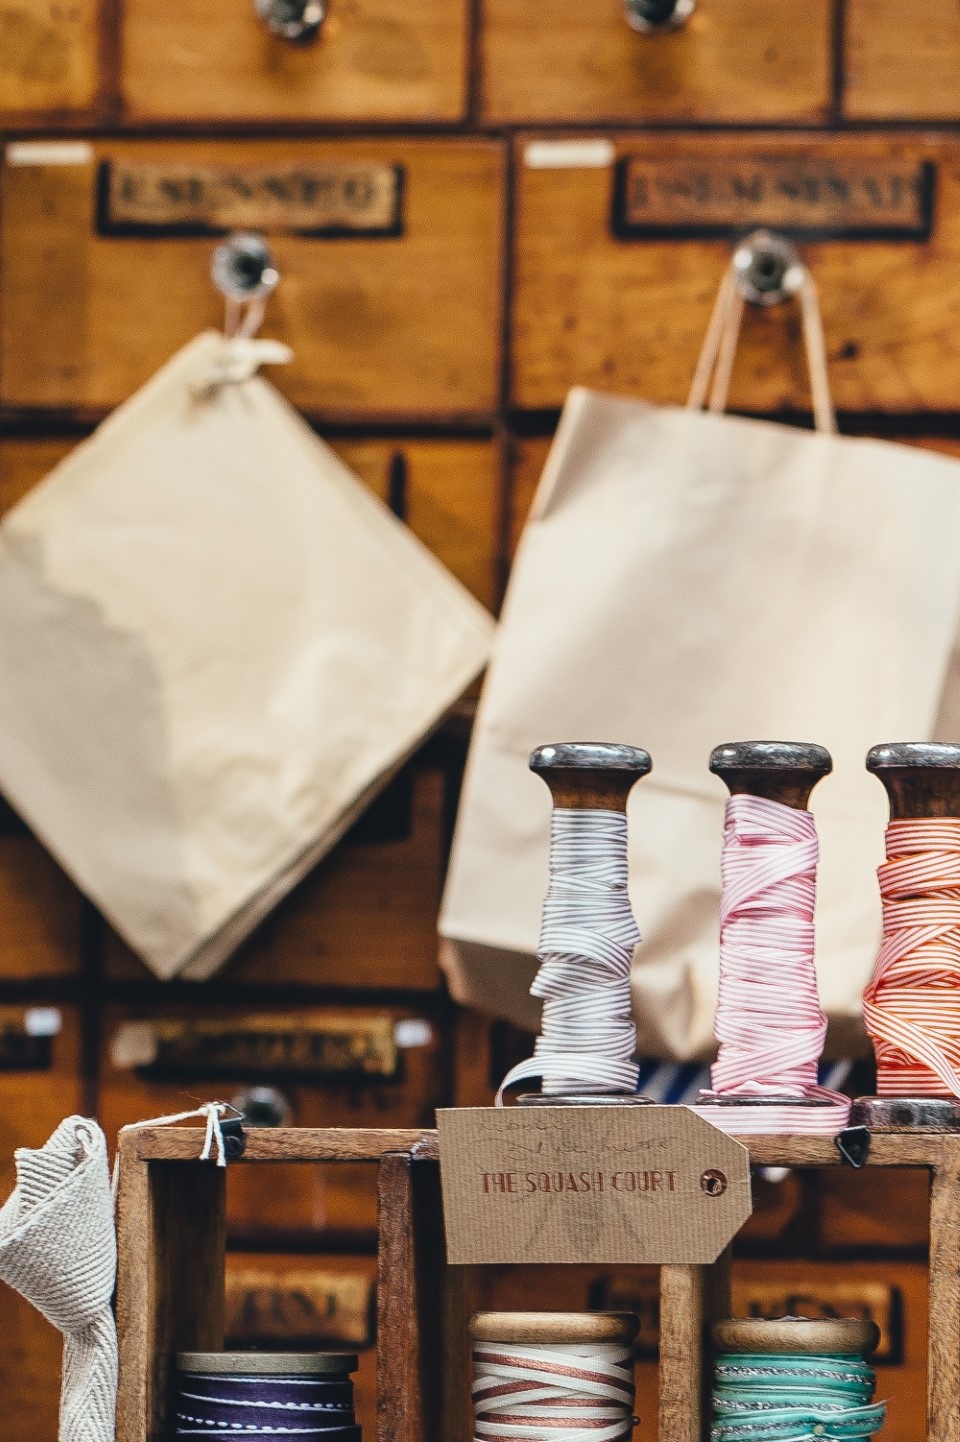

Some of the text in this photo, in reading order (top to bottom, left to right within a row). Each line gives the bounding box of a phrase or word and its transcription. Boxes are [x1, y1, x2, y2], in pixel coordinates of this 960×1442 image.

[480, 1170, 677, 1194] THE SQUASH COURT
